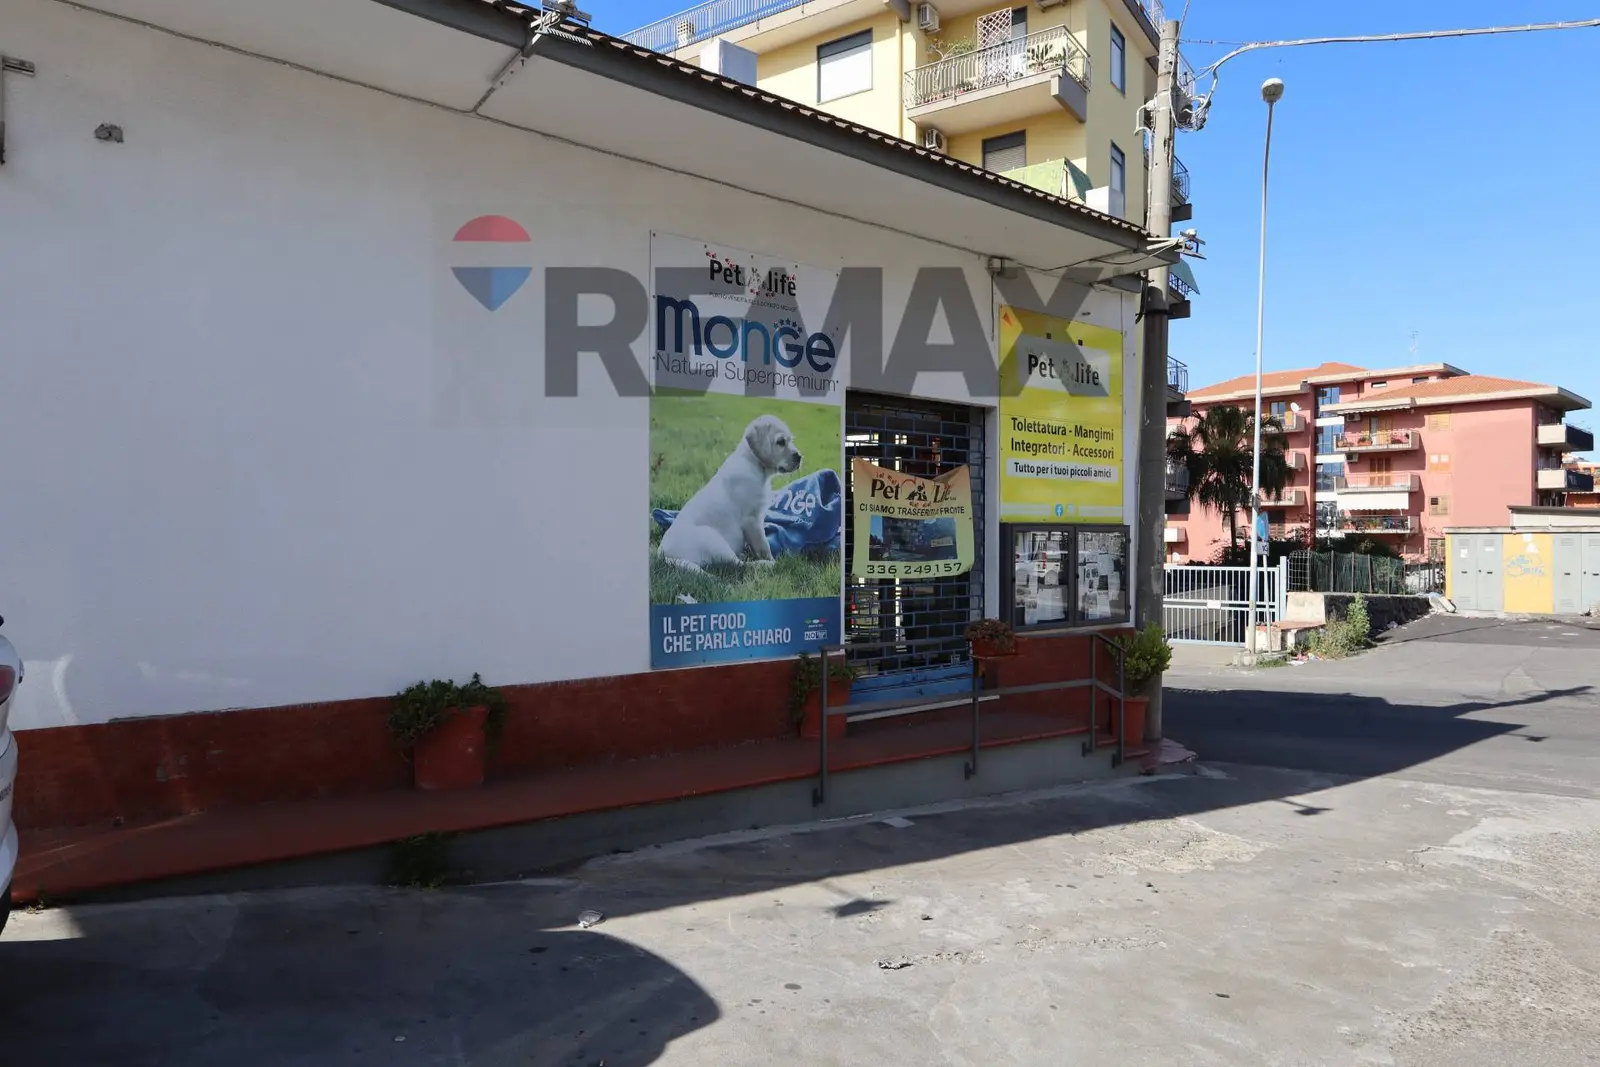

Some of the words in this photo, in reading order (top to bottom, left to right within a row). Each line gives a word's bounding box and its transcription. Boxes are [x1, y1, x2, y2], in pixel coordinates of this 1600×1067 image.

[709, 258, 742, 287] Pet
[768, 270, 797, 297] life
[656, 352, 719, 379] Natural
[724, 361, 838, 393] Superpremium
[1028, 353, 1055, 379] Pet
[1074, 362, 1100, 386] life
[1010, 417, 1067, 436] Tolettatura
[1074, 424, 1114, 443] Mangimi
[1010, 437, 1065, 457] Integratori
[1072, 443, 1115, 459] Accessori
[1013, 462, 1035, 474] Tutto
[1036, 465, 1049, 476] per
[1054, 465, 1069, 476] tuoi
[1070, 467, 1092, 478] piccoli
[1093, 468, 1112, 478] amici
[870, 478, 901, 501] Pet
[859, 503, 868, 512] CI
[869, 504, 896, 514] SIAMO
[866, 564, 898, 575] 336
[903, 562, 963, 575] 249157
[663, 616, 677, 634] IL
[680, 614, 707, 633] PET
[710, 612, 747, 630] FOOD
[663, 633, 692, 654] CHE
[696, 631, 741, 651] PARLA
[743, 627, 792, 647] CHIARO
